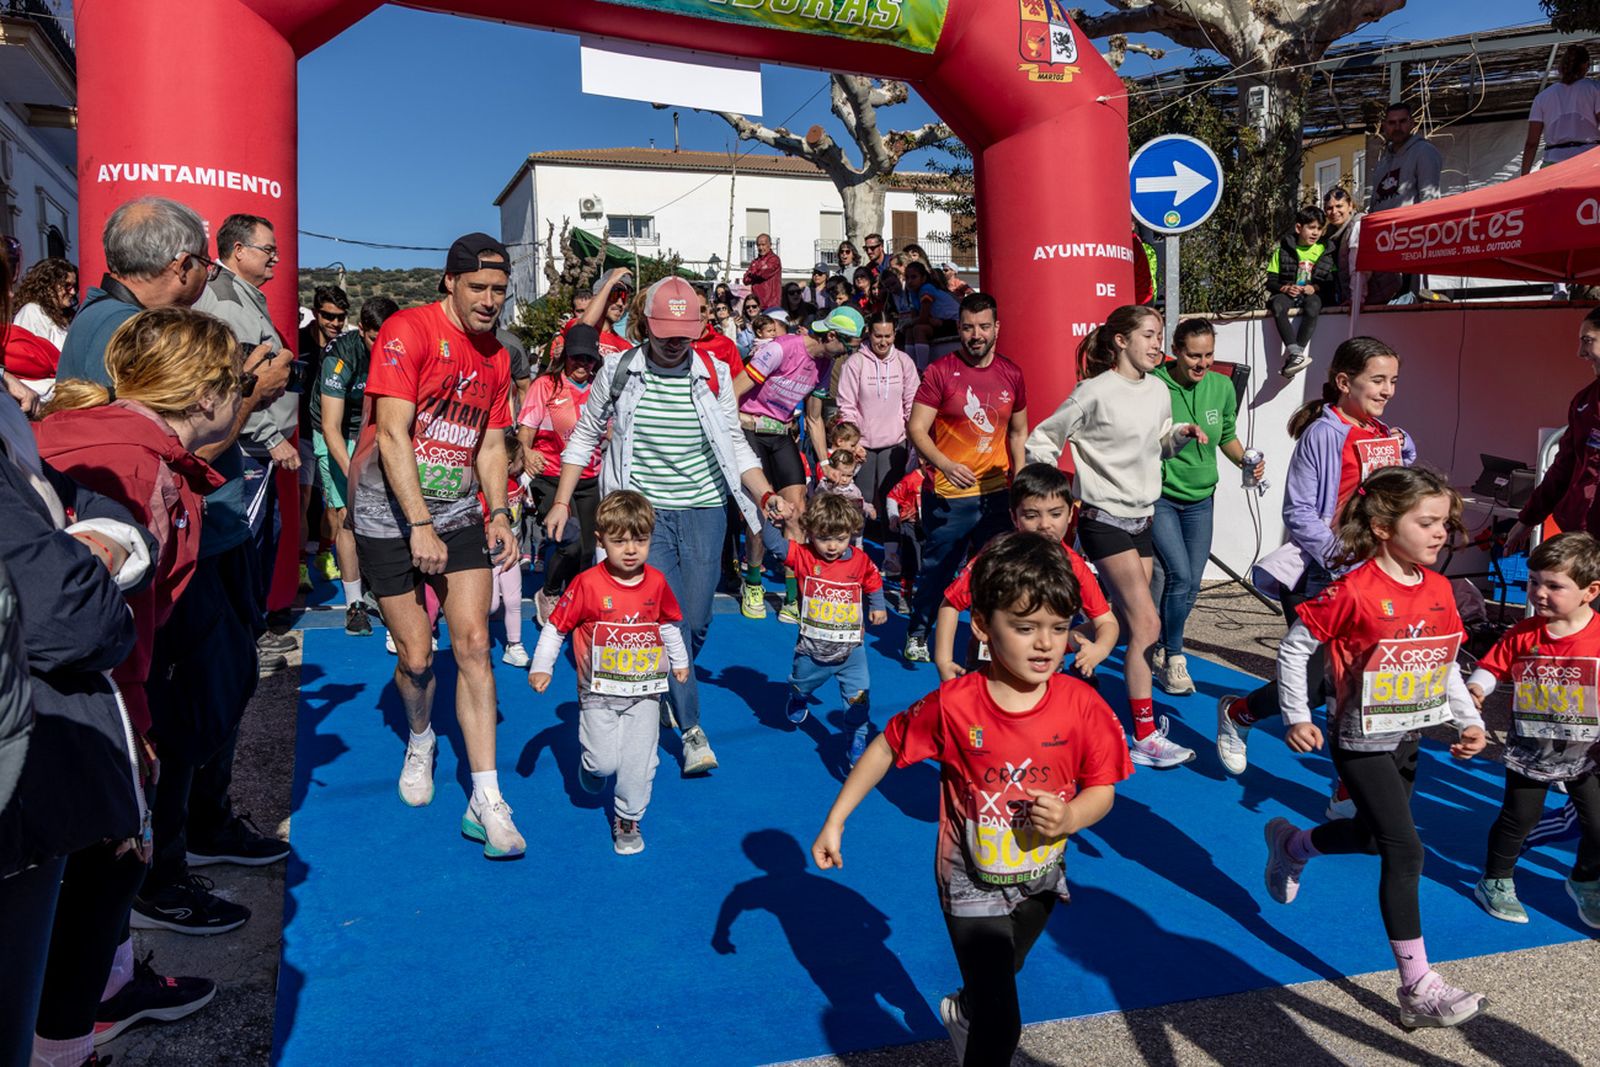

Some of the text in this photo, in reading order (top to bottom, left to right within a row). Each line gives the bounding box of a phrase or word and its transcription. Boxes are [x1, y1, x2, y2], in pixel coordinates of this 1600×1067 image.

[1037, 73, 1065, 81] MARTOS
[97, 163, 283, 199] AYUNTAMIENTO
[1486, 239, 1522, 252] OUTDOOR
[1095, 283, 1117, 297] DE
[415, 438, 467, 461] X CROSS
[809, 598, 859, 623] 5058
[607, 627, 656, 643] X CROSS
[601, 648, 662, 673] 5057
[1380, 646, 1448, 663] X CROSS
[1522, 661, 1582, 679] X CROSS
[1372, 665, 1448, 702] 5012
[1517, 684, 1585, 713] 5031
[984, 766, 1051, 784] CROSS
[980, 790, 1001, 815] X
